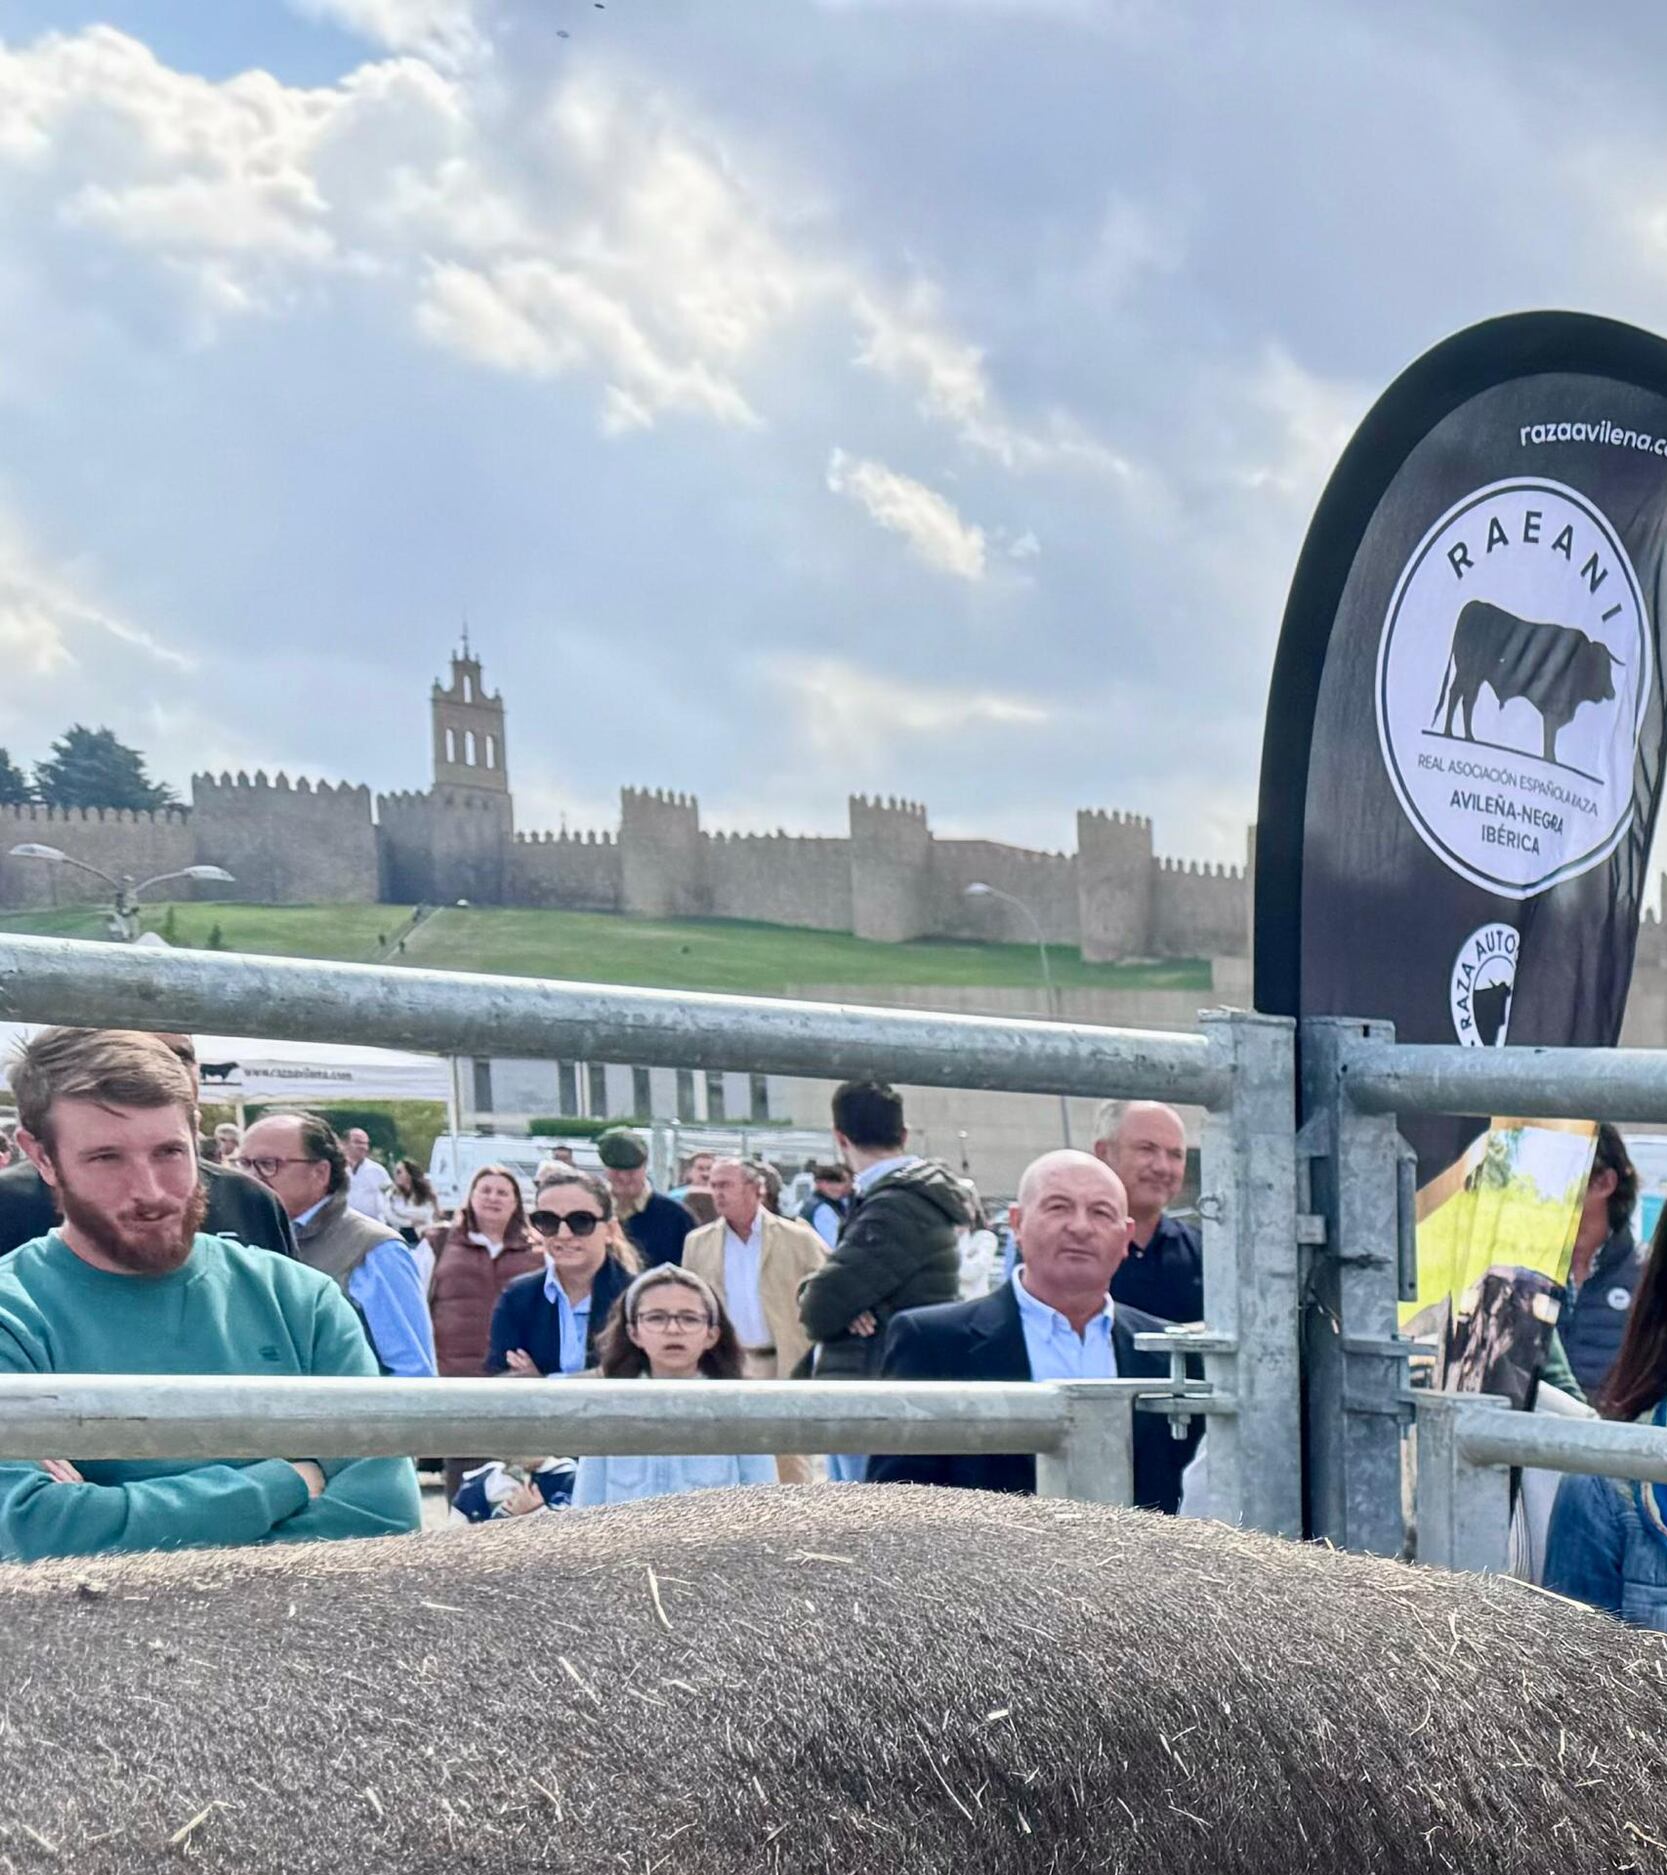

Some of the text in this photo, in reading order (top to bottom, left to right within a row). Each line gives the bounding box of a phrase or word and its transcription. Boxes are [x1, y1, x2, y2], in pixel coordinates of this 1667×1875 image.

[1447, 510, 1622, 623] RAEANI
[1417, 754, 1446, 772] REAL
[1448, 758, 1518, 787] ASOCIACIÓN
[1450, 789, 1564, 835] AVILEÑA-NEGRA
[1481, 823, 1540, 856] IBÉRICA
[1456, 929, 1518, 1031] RAZA AUTO
